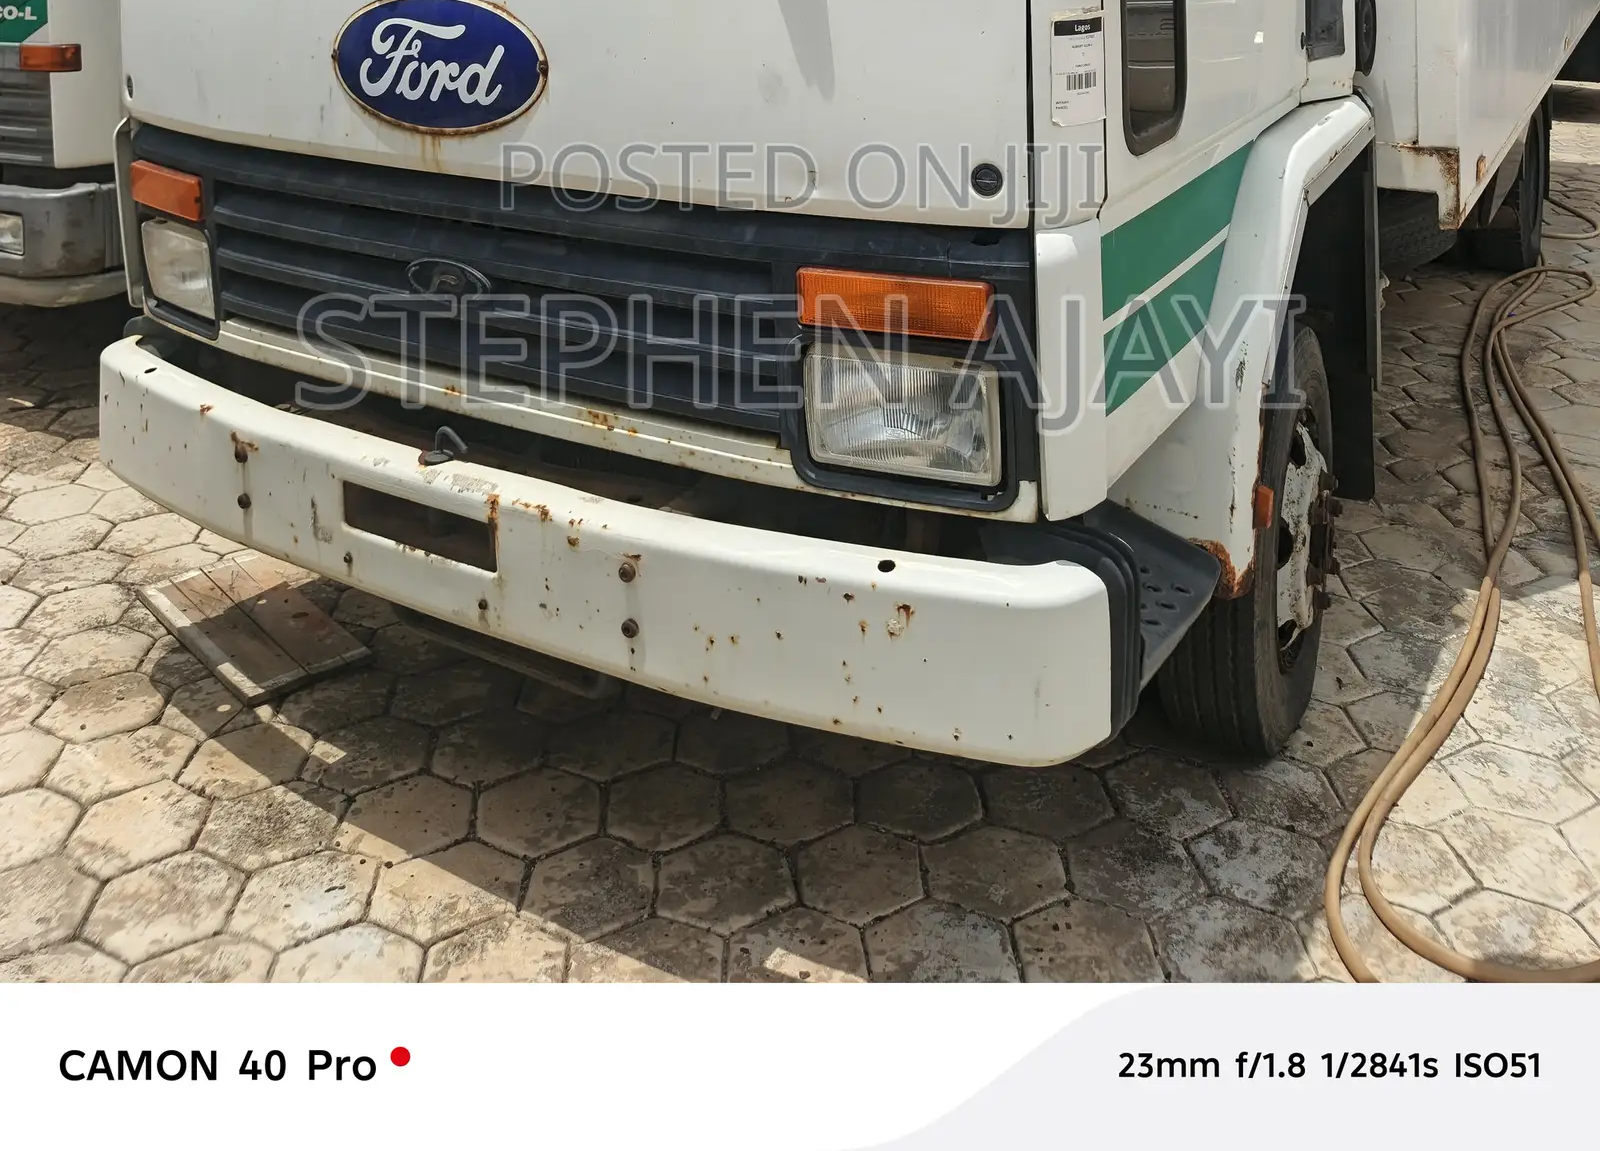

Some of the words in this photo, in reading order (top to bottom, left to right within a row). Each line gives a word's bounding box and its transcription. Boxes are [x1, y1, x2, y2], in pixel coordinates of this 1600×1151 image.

[0, 5, 38, 21] O-L
[1074, 24, 1091, 33] Lagos
[360, 17, 505, 106] Ford
